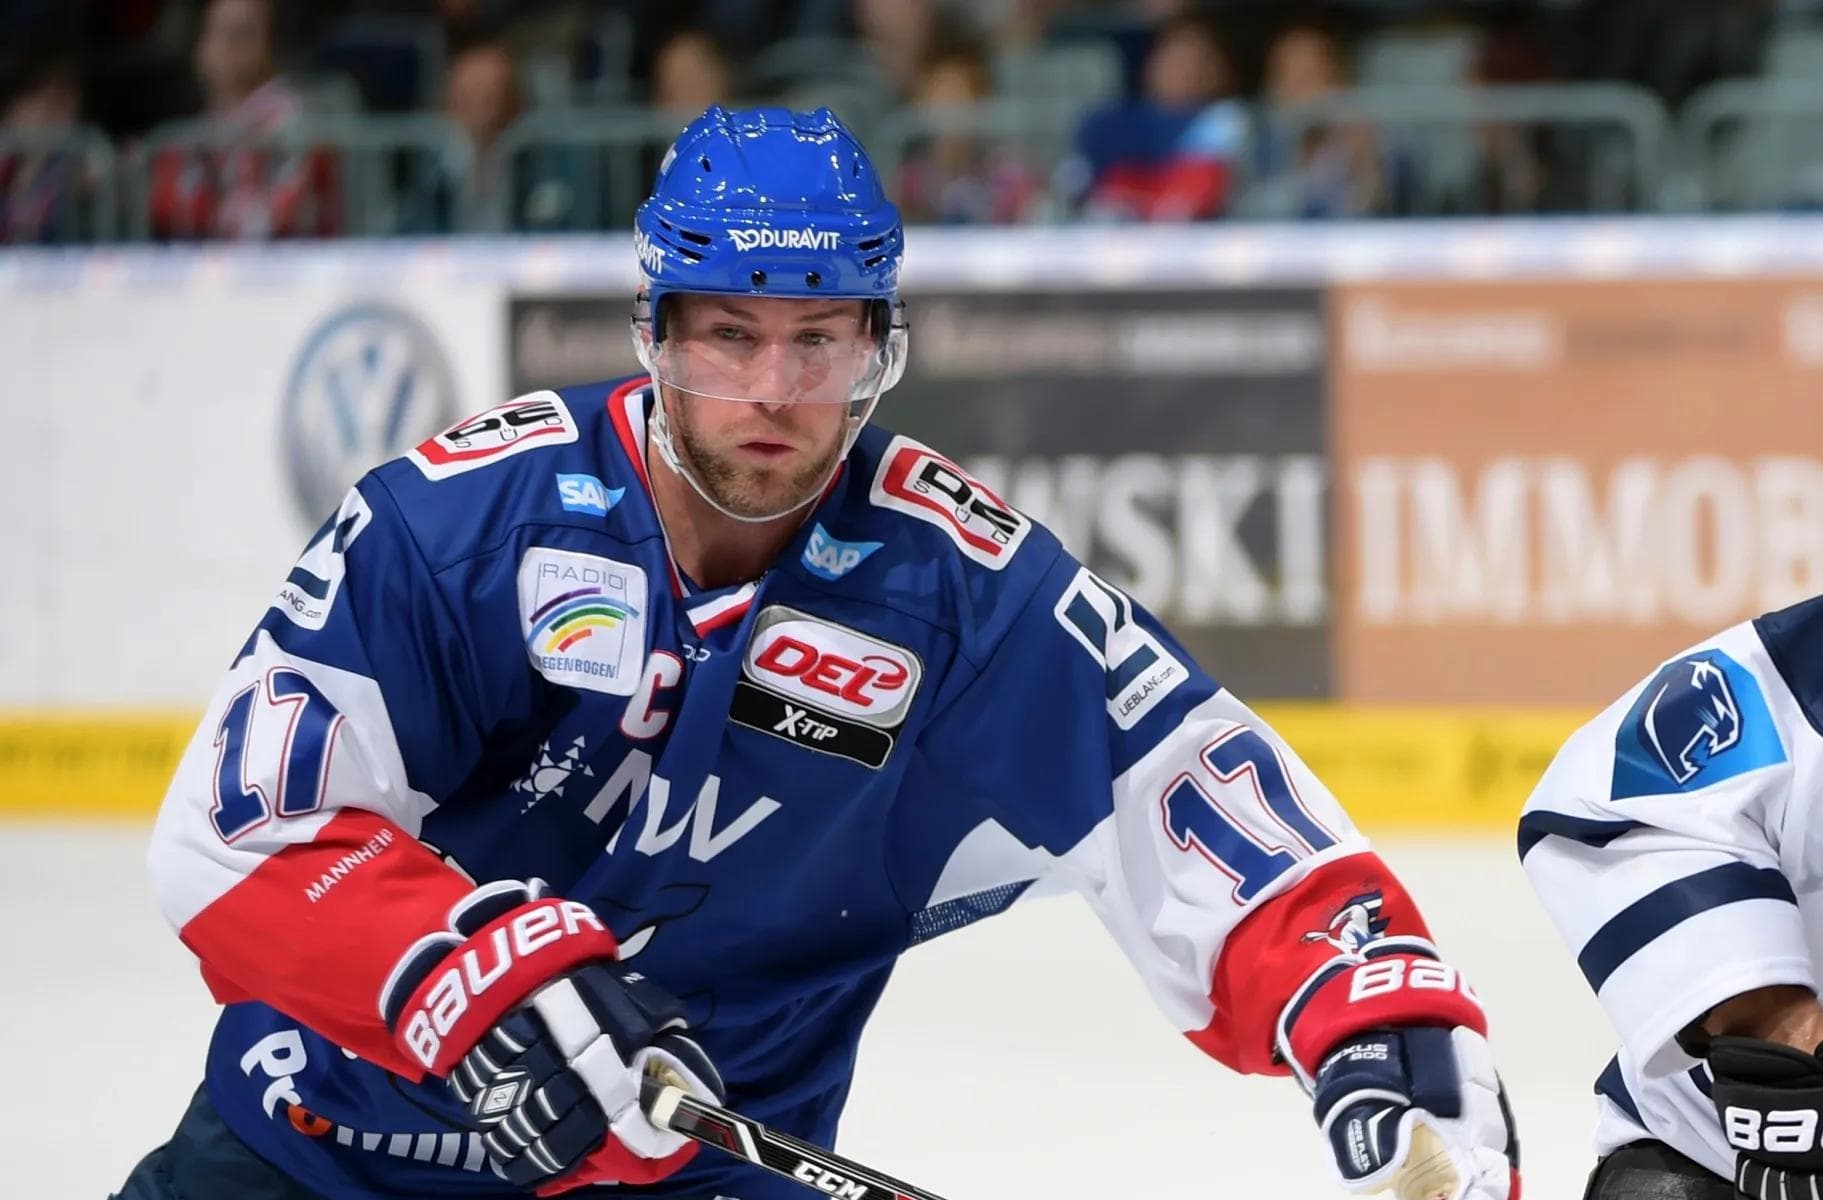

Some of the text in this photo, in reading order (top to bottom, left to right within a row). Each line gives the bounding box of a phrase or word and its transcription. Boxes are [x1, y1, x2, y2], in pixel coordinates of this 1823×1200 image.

[757, 228, 841, 251] DURAVIT
[541, 563, 624, 591] RADIO
[804, 527, 861, 575] SAP
[541, 655, 617, 679] EGENBOGEN
[618, 649, 686, 740] C
[755, 634, 906, 708] DEL
[209, 666, 345, 845] 17
[1160, 725, 1342, 907] 17
